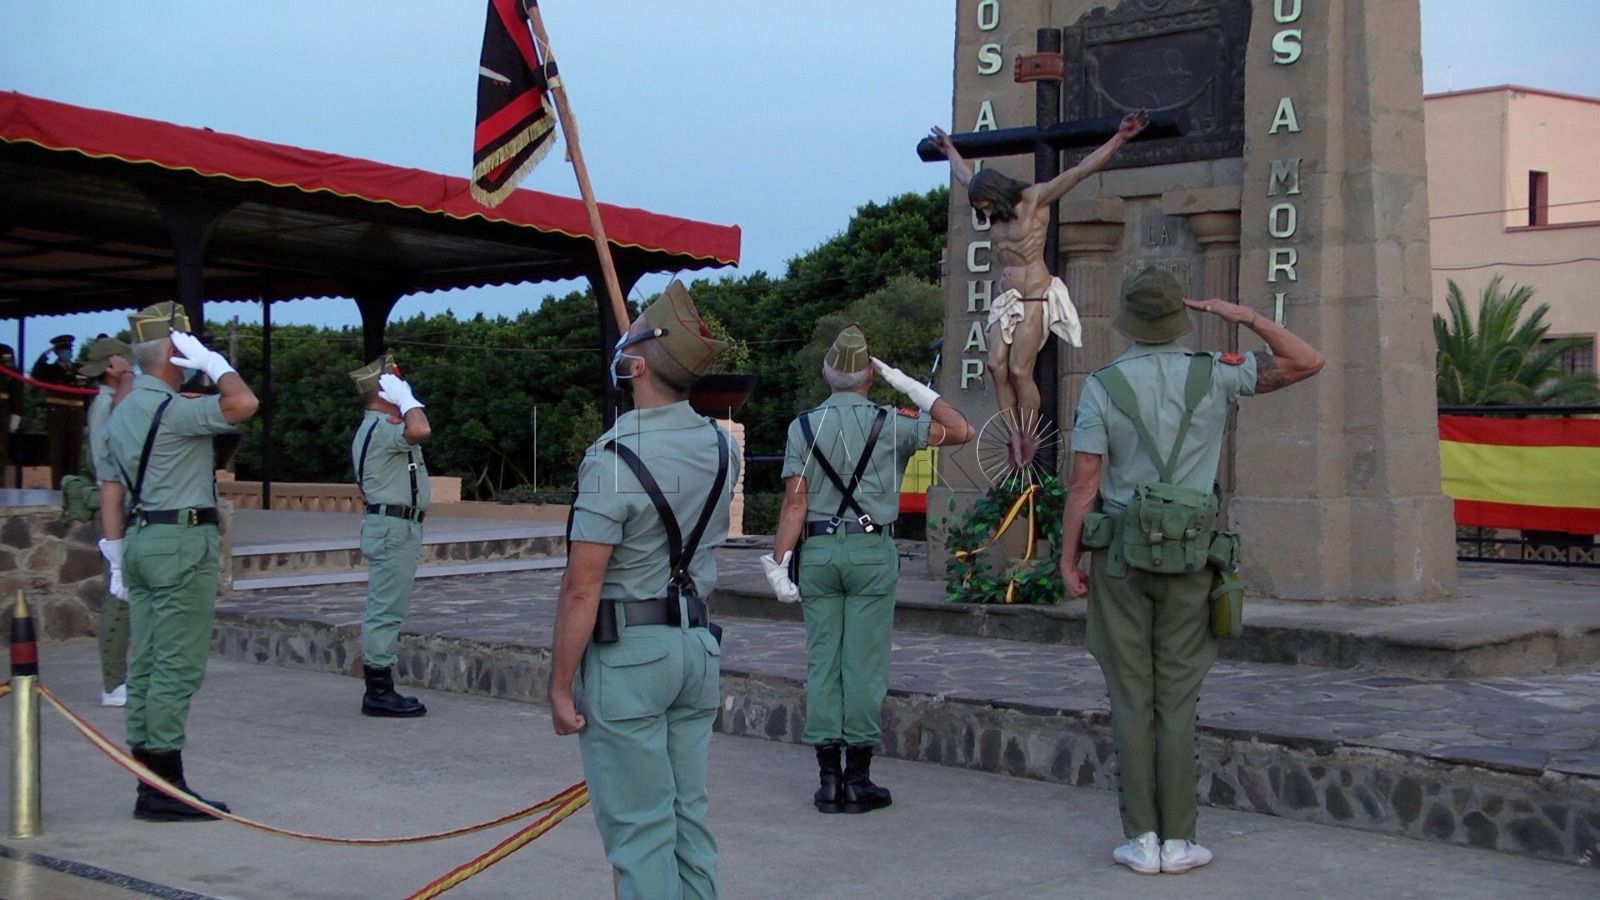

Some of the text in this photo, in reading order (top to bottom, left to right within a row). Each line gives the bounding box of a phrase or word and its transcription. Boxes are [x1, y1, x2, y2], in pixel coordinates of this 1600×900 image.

[972, 100, 999, 133] A
[1268, 97, 1301, 135] A
[1145, 223, 1171, 247] LA
[960, 160, 993, 390] UCHAR
[1266, 158, 1302, 355] MORI
